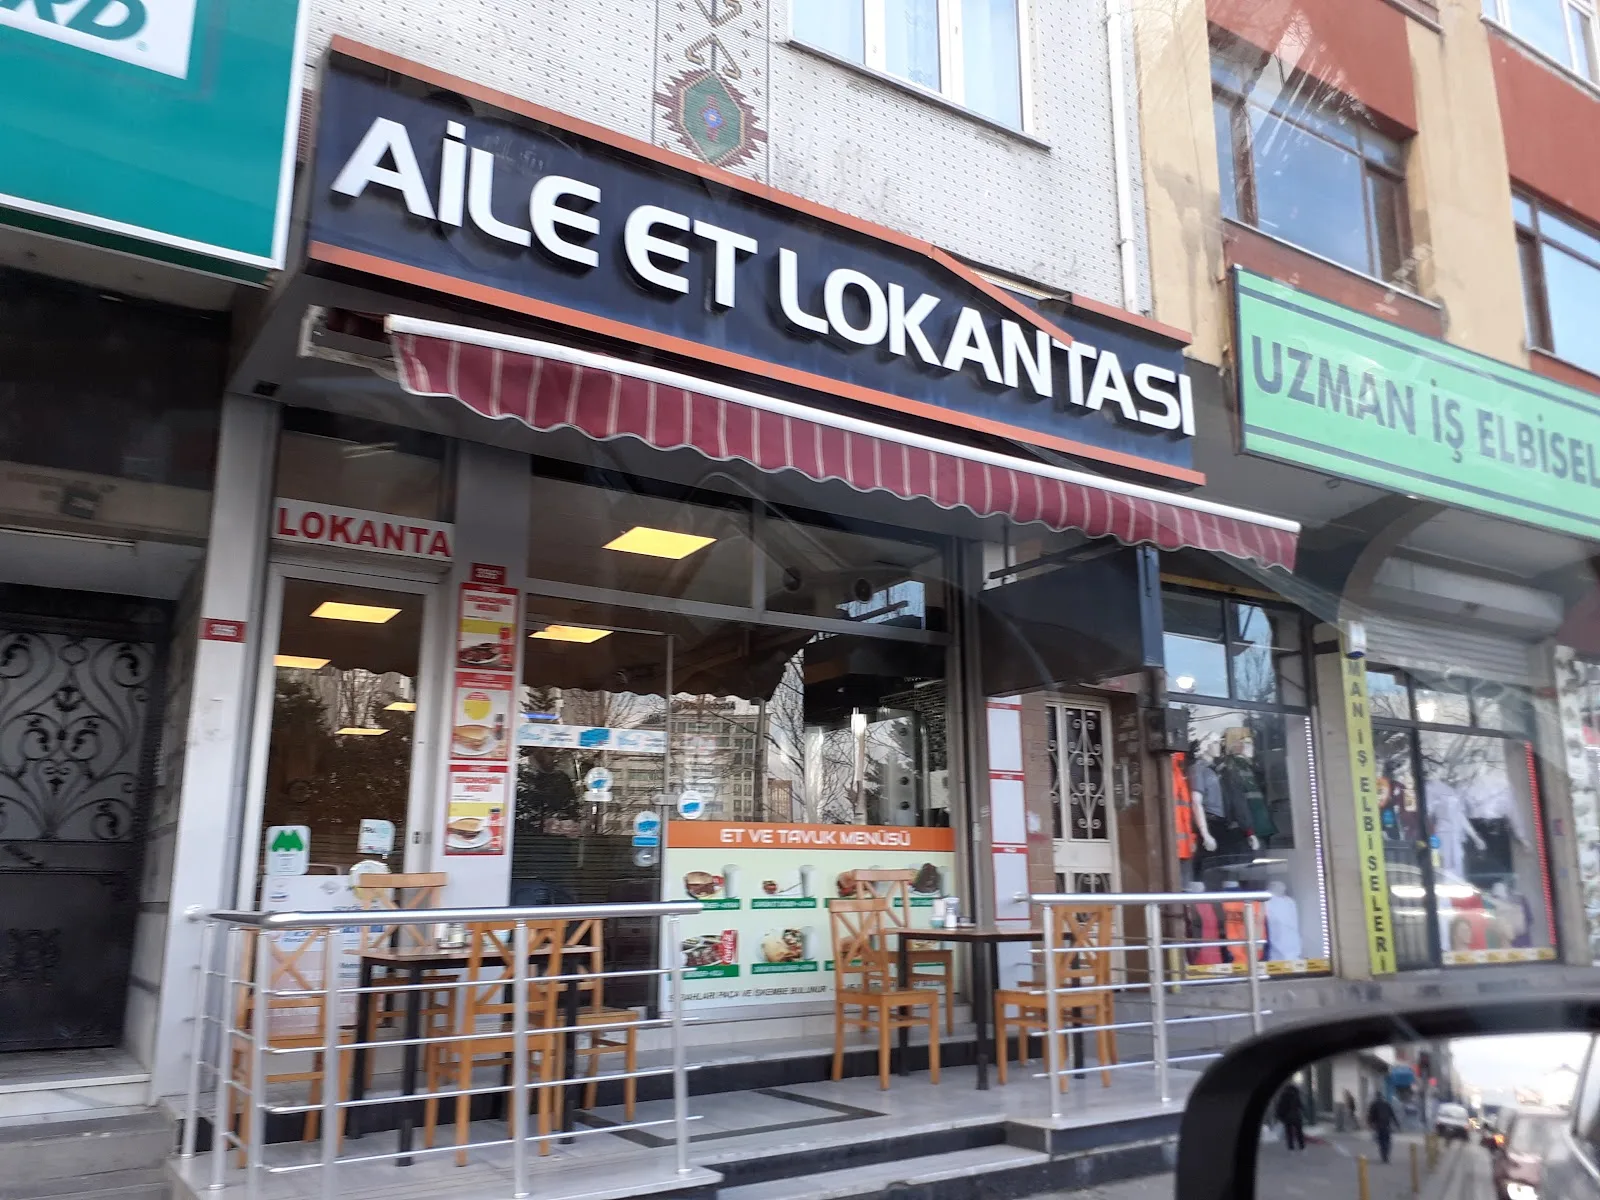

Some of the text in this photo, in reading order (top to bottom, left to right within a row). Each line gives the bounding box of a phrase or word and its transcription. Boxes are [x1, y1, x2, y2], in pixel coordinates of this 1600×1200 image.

[331, 116, 1196, 437] AİLE ET LOKANTASI
[1251, 335, 1600, 489] UZMAN İŞ ELBİSEL
[277, 507, 452, 557] LOKANTA
[720, 828, 911, 847] ET VE TAVUK MENÜSÜ
